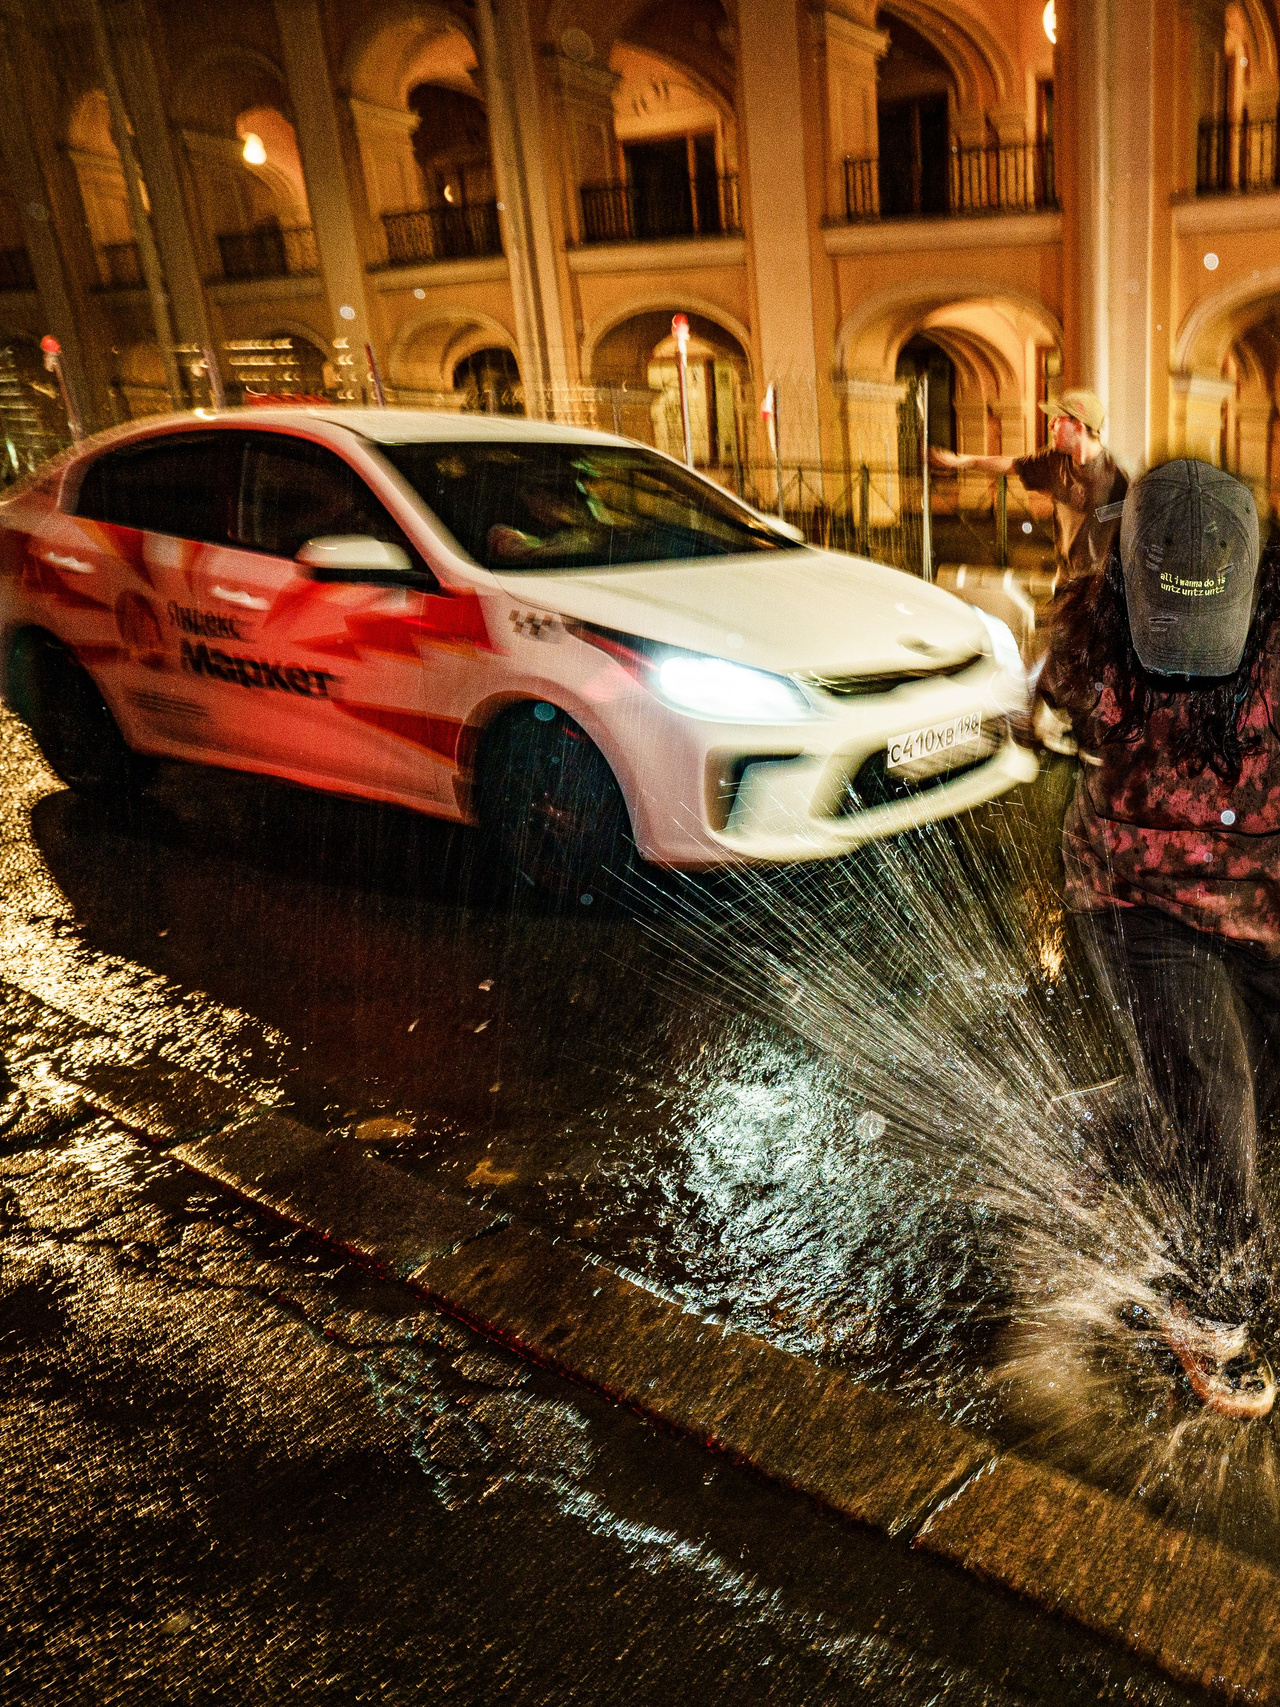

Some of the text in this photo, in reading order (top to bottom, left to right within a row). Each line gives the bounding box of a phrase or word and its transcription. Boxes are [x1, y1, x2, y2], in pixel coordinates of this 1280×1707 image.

[1160, 572, 1173, 583] all
[1180, 579, 1203, 588] wanna
[1203, 578, 1215, 588] do
[1218, 575, 1226, 585] is
[1160, 582, 1225, 597] untz untz untz
[180, 638, 342, 698] Маркет
